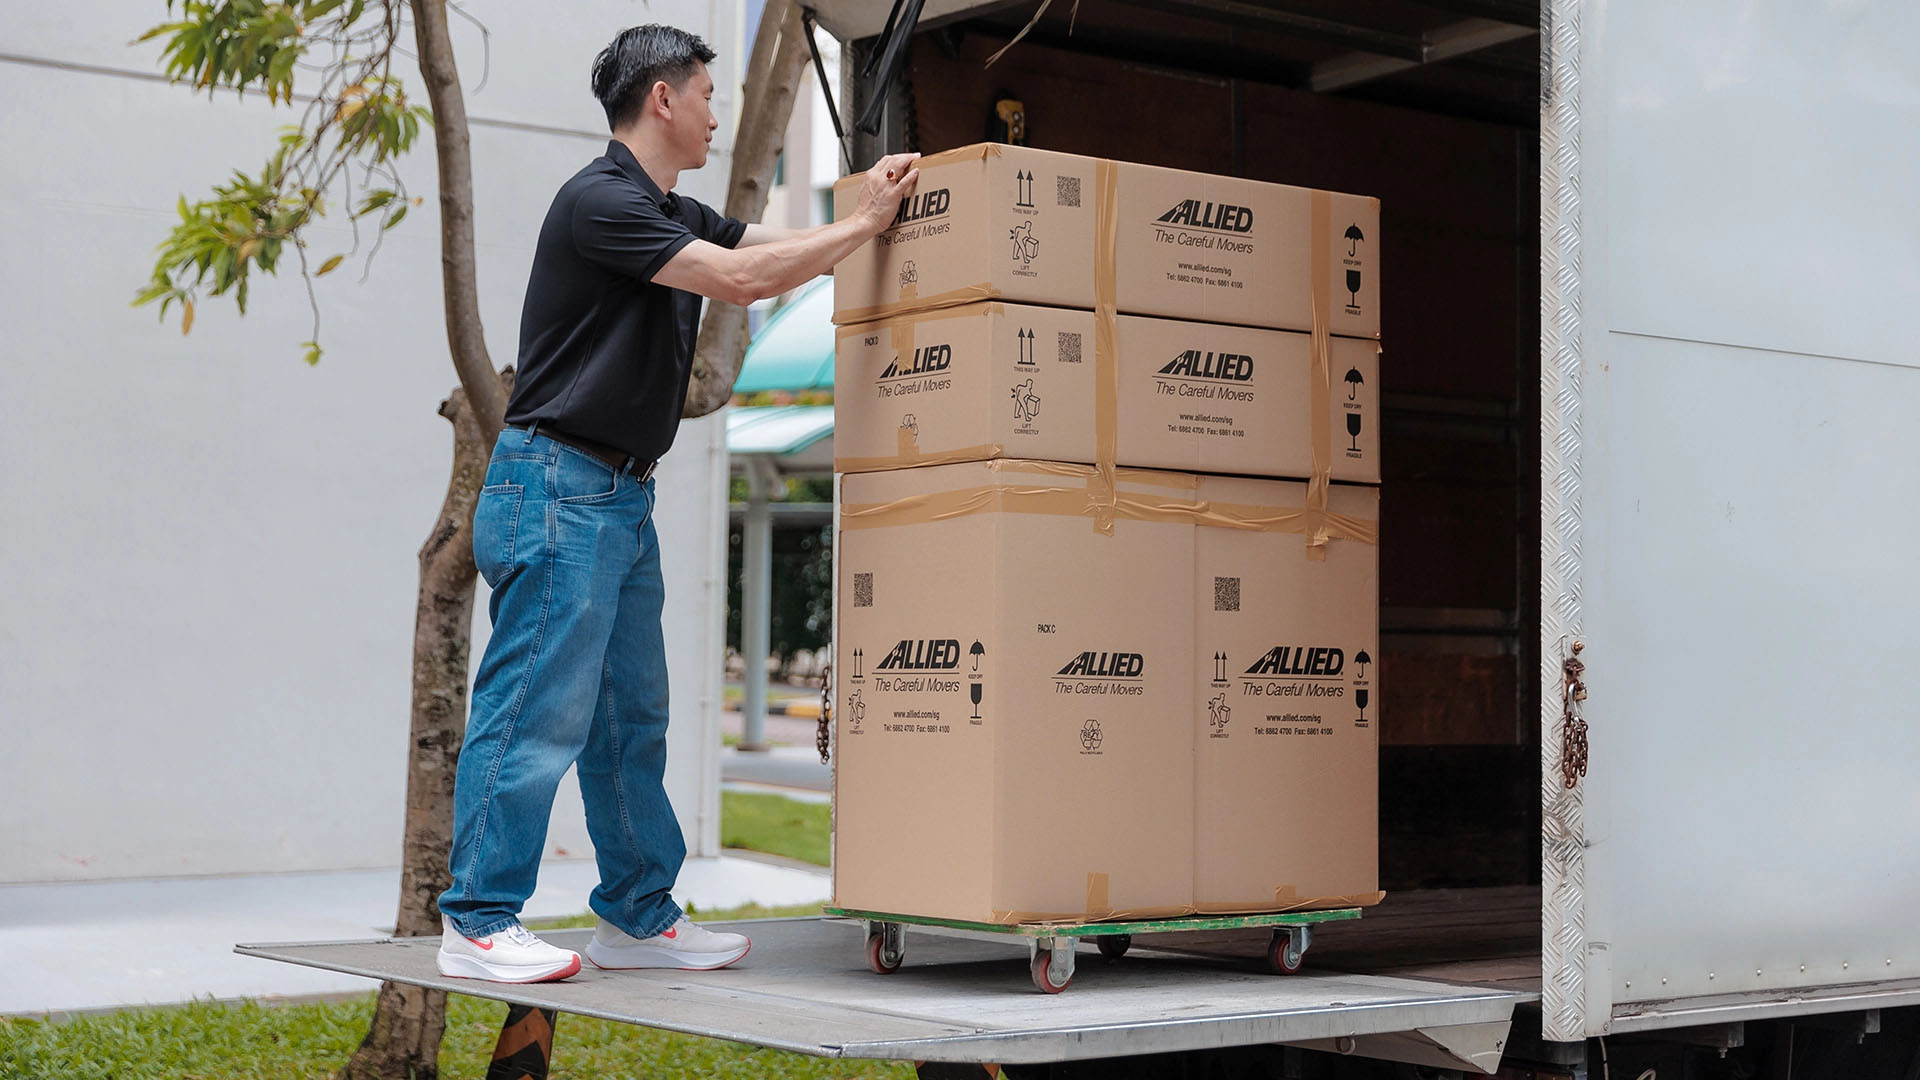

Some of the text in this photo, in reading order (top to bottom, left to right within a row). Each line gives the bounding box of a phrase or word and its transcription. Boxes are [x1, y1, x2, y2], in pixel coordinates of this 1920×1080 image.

[1156, 199, 1253, 233] ALLIED
[878, 223, 950, 247] The Careful Movers
[1155, 229, 1254, 254] The Careful Movers
[1178, 263, 1232, 276] www.allied.com/sg
[1166, 272, 1176, 280] Tel:
[1205, 278, 1216, 286] Fax:
[1158, 350, 1254, 382] ALLIED
[878, 379, 951, 398] The Careful Movers
[1156, 382, 1254, 402] The Careful Movers
[1179, 414, 1232, 426] www.allied.com/sg
[1038, 624, 1056, 634] PACK C
[876, 640, 960, 669] ALLIED
[1245, 646, 1344, 676] ALLIED
[1056, 652, 1144, 676] ALLIED
[875, 678, 960, 692] The Careful Movers
[1056, 682, 1144, 696] The Careful Movers
[1243, 682, 1344, 697] The Careful Movers
[893, 710, 940, 720] www.allied.com/sg
[1266, 714, 1322, 724] www.allied.com/sg
[939, 725, 950, 733] 4100
